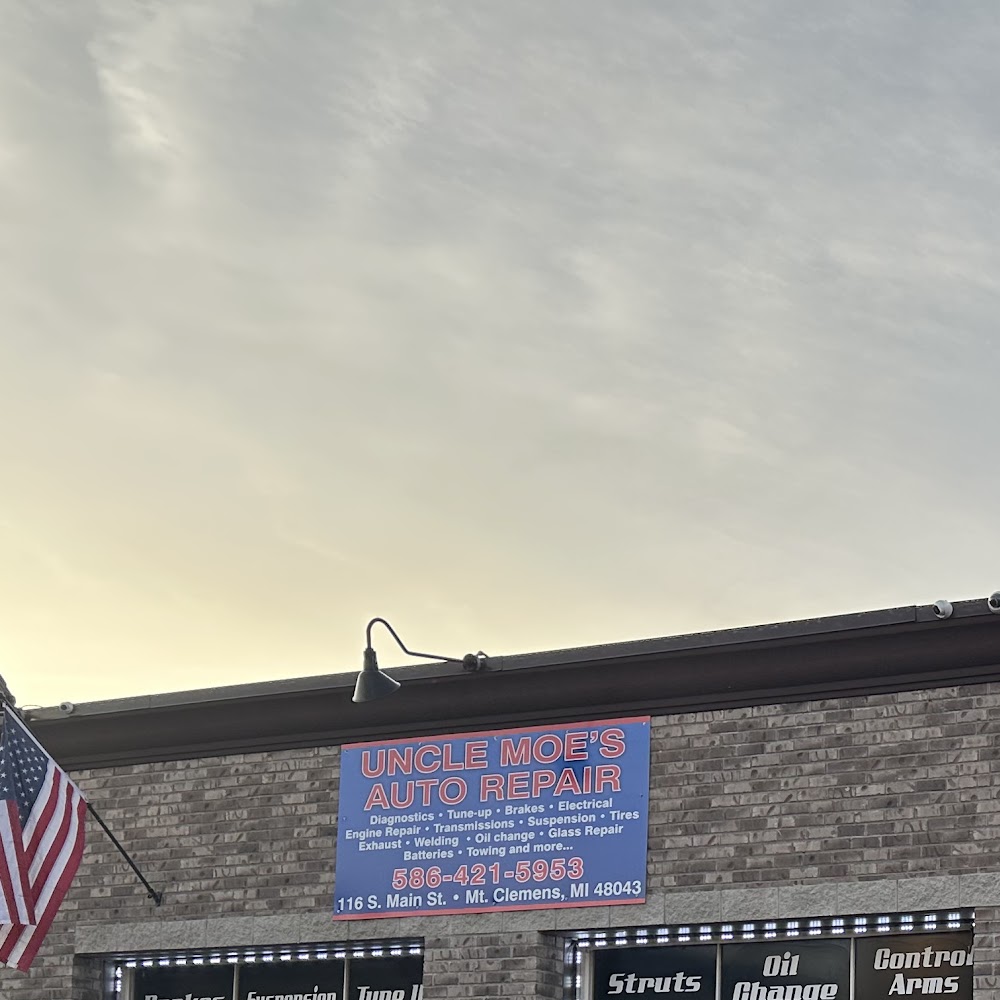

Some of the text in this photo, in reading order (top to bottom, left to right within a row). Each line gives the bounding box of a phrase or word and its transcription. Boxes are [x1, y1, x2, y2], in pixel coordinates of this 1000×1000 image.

[361, 728, 626, 779] UNCLE MOE'S
[364, 764, 622, 811] AUTO REPAIR
[345, 810, 640, 842] Engine Repair Transmissions Suspension Tires
[370, 798, 613, 826] Diagnostics Tune-up Brakes Electrical
[358, 824, 623, 852] Exhaust Welding Oil change Glass Repair
[403, 842, 573, 861] Batteries Towing and more...
[391, 857, 584, 890] 586-421-5953
[337, 880, 641, 911] 116 S. Main St. Mt. Clemens, MI 48043
[762, 951, 800, 977] Oil
[607, 971, 702, 995] Struts
[888, 973, 960, 997] Arms
